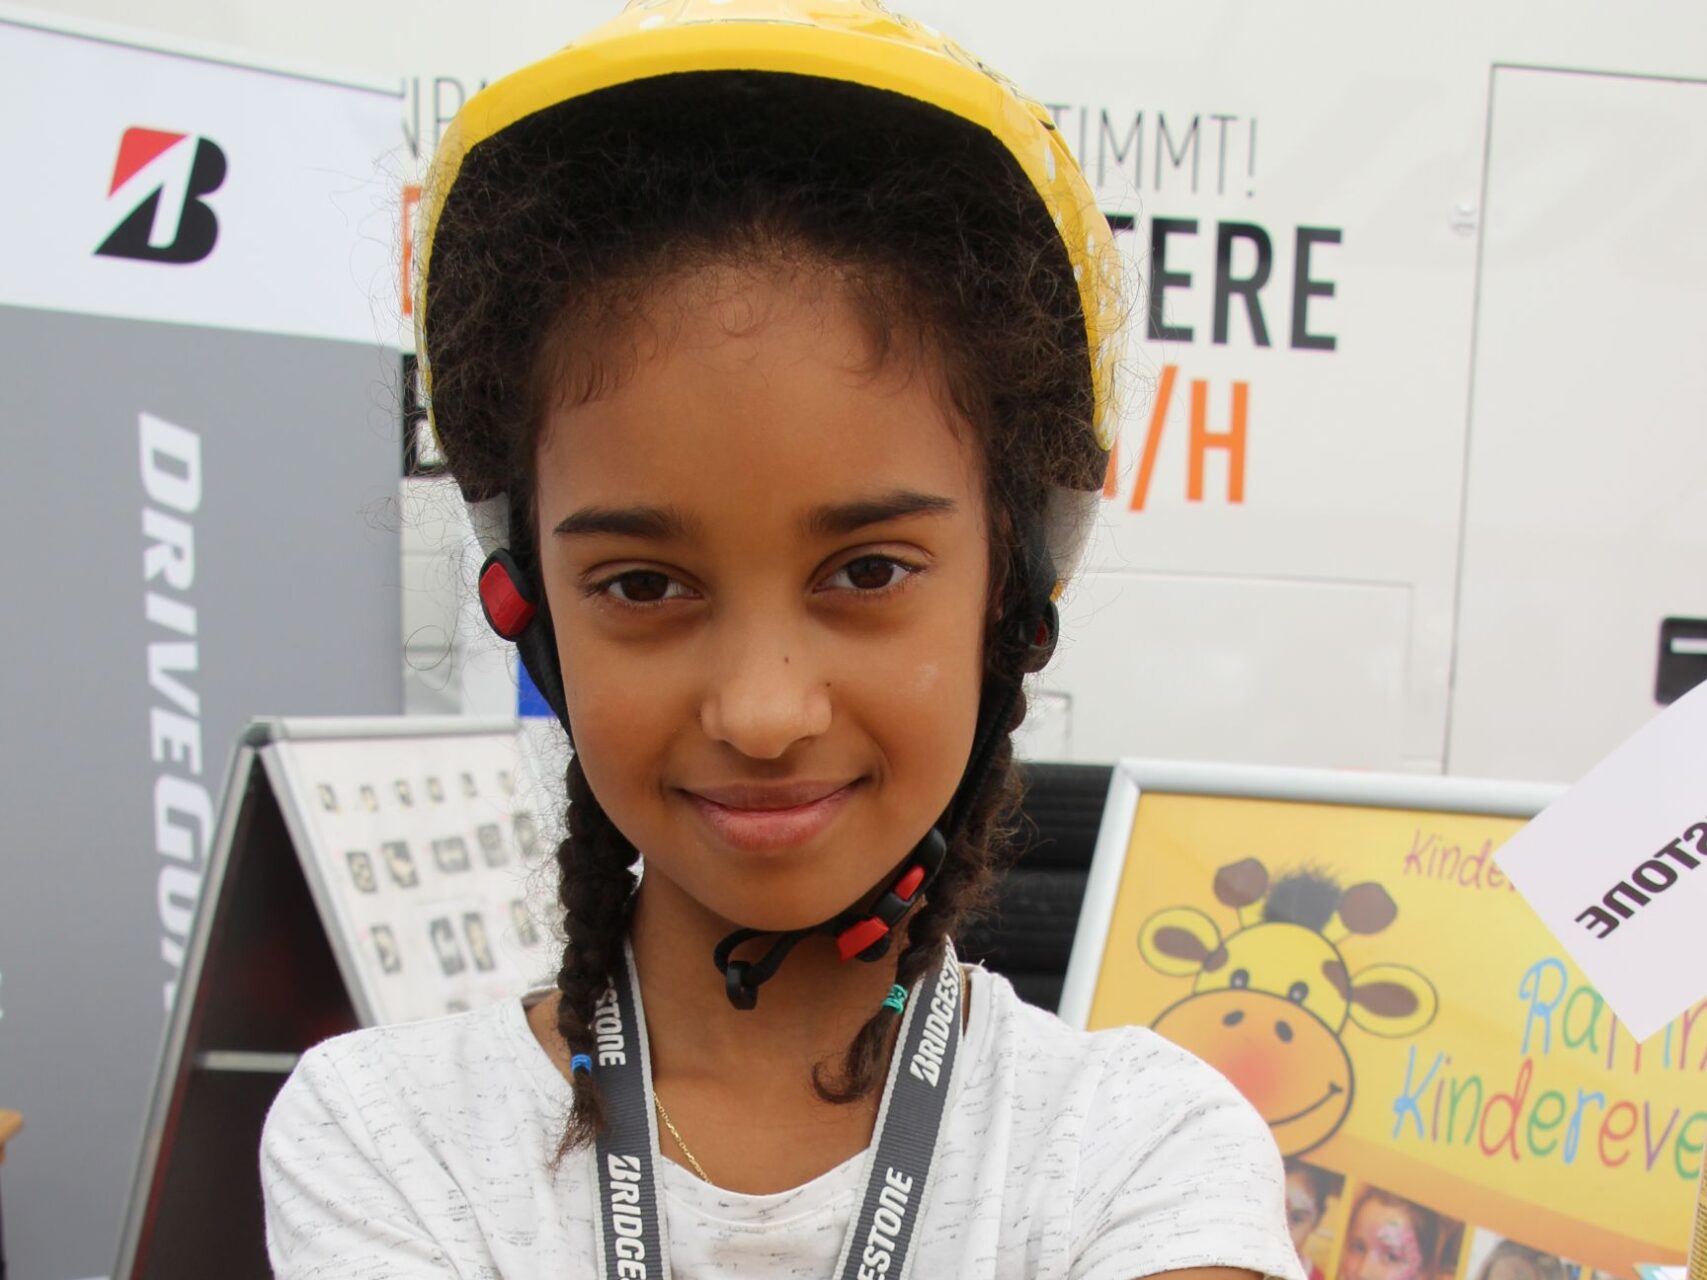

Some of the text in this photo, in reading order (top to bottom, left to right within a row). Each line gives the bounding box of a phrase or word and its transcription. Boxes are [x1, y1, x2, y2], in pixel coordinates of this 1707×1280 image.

[1045, 104, 1257, 198] TIMMT!
[1102, 363, 1250, 513] /H
[138, 411, 216, 1013] DRIVEGU
[1403, 828, 1516, 893] Kinde
[595, 977, 627, 1067] STONE
[1393, 1045, 1707, 1180] Kindereve
